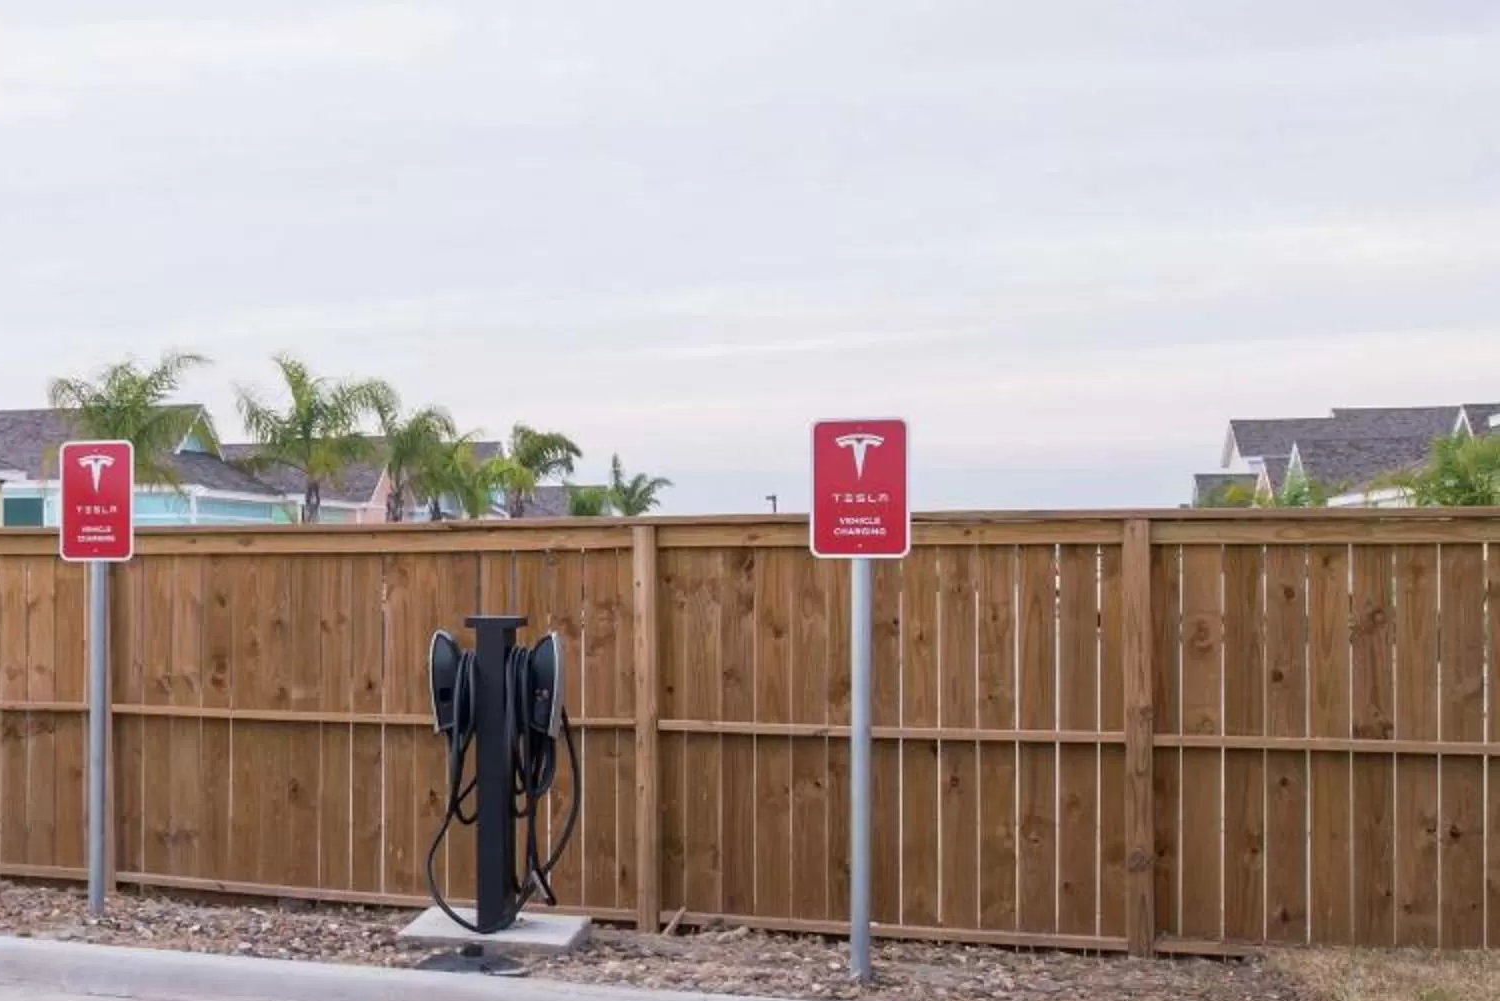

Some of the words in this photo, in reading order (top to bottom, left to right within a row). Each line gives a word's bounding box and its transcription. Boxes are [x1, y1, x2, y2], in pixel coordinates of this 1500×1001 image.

[832, 492, 889, 503] TESLA
[839, 517, 881, 525] VEHICLE
[833, 527, 887, 535] CHARGING
